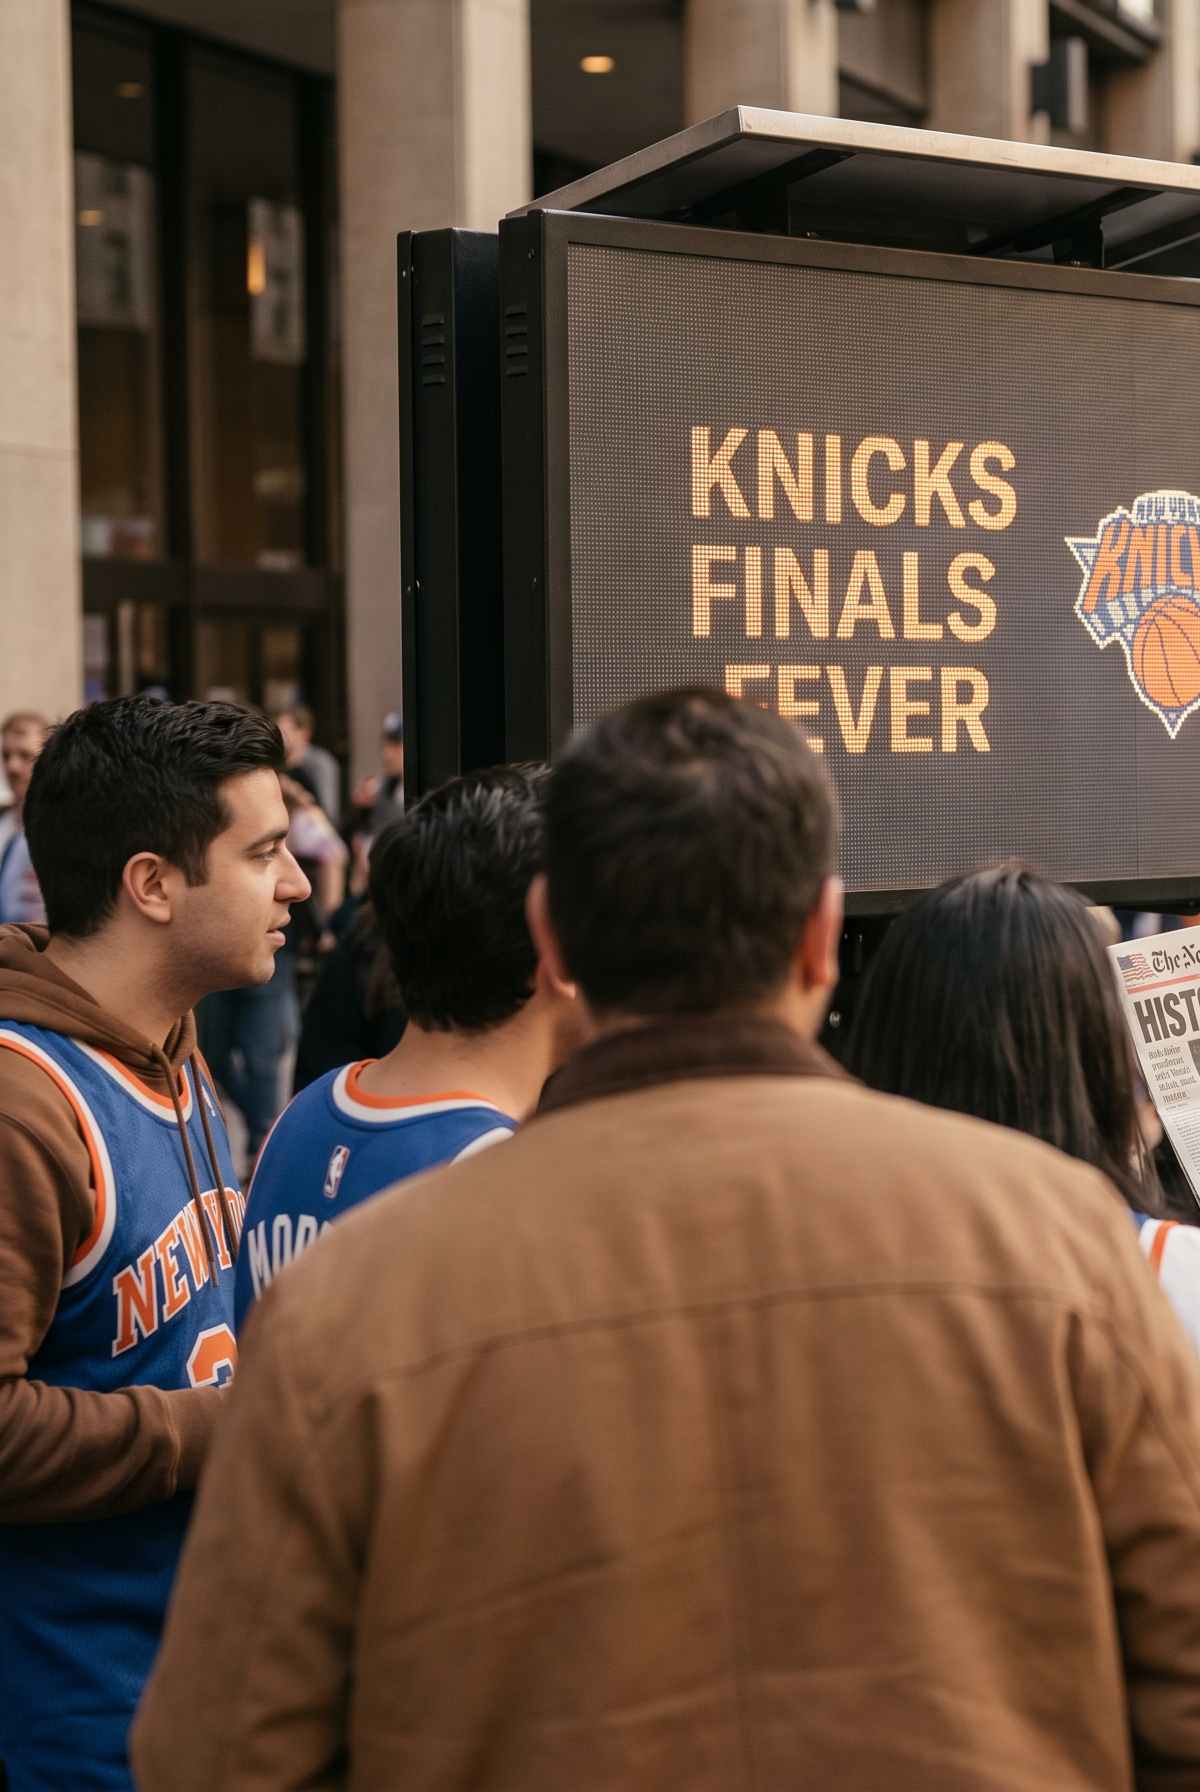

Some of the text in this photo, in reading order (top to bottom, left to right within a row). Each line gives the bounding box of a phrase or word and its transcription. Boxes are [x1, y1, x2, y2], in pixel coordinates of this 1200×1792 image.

[692, 426, 1017, 530] KNICKS
[692, 544, 998, 643] FINALS
[1151, 950, 1181, 974] The
[111, 1198, 210, 1358] NEW
